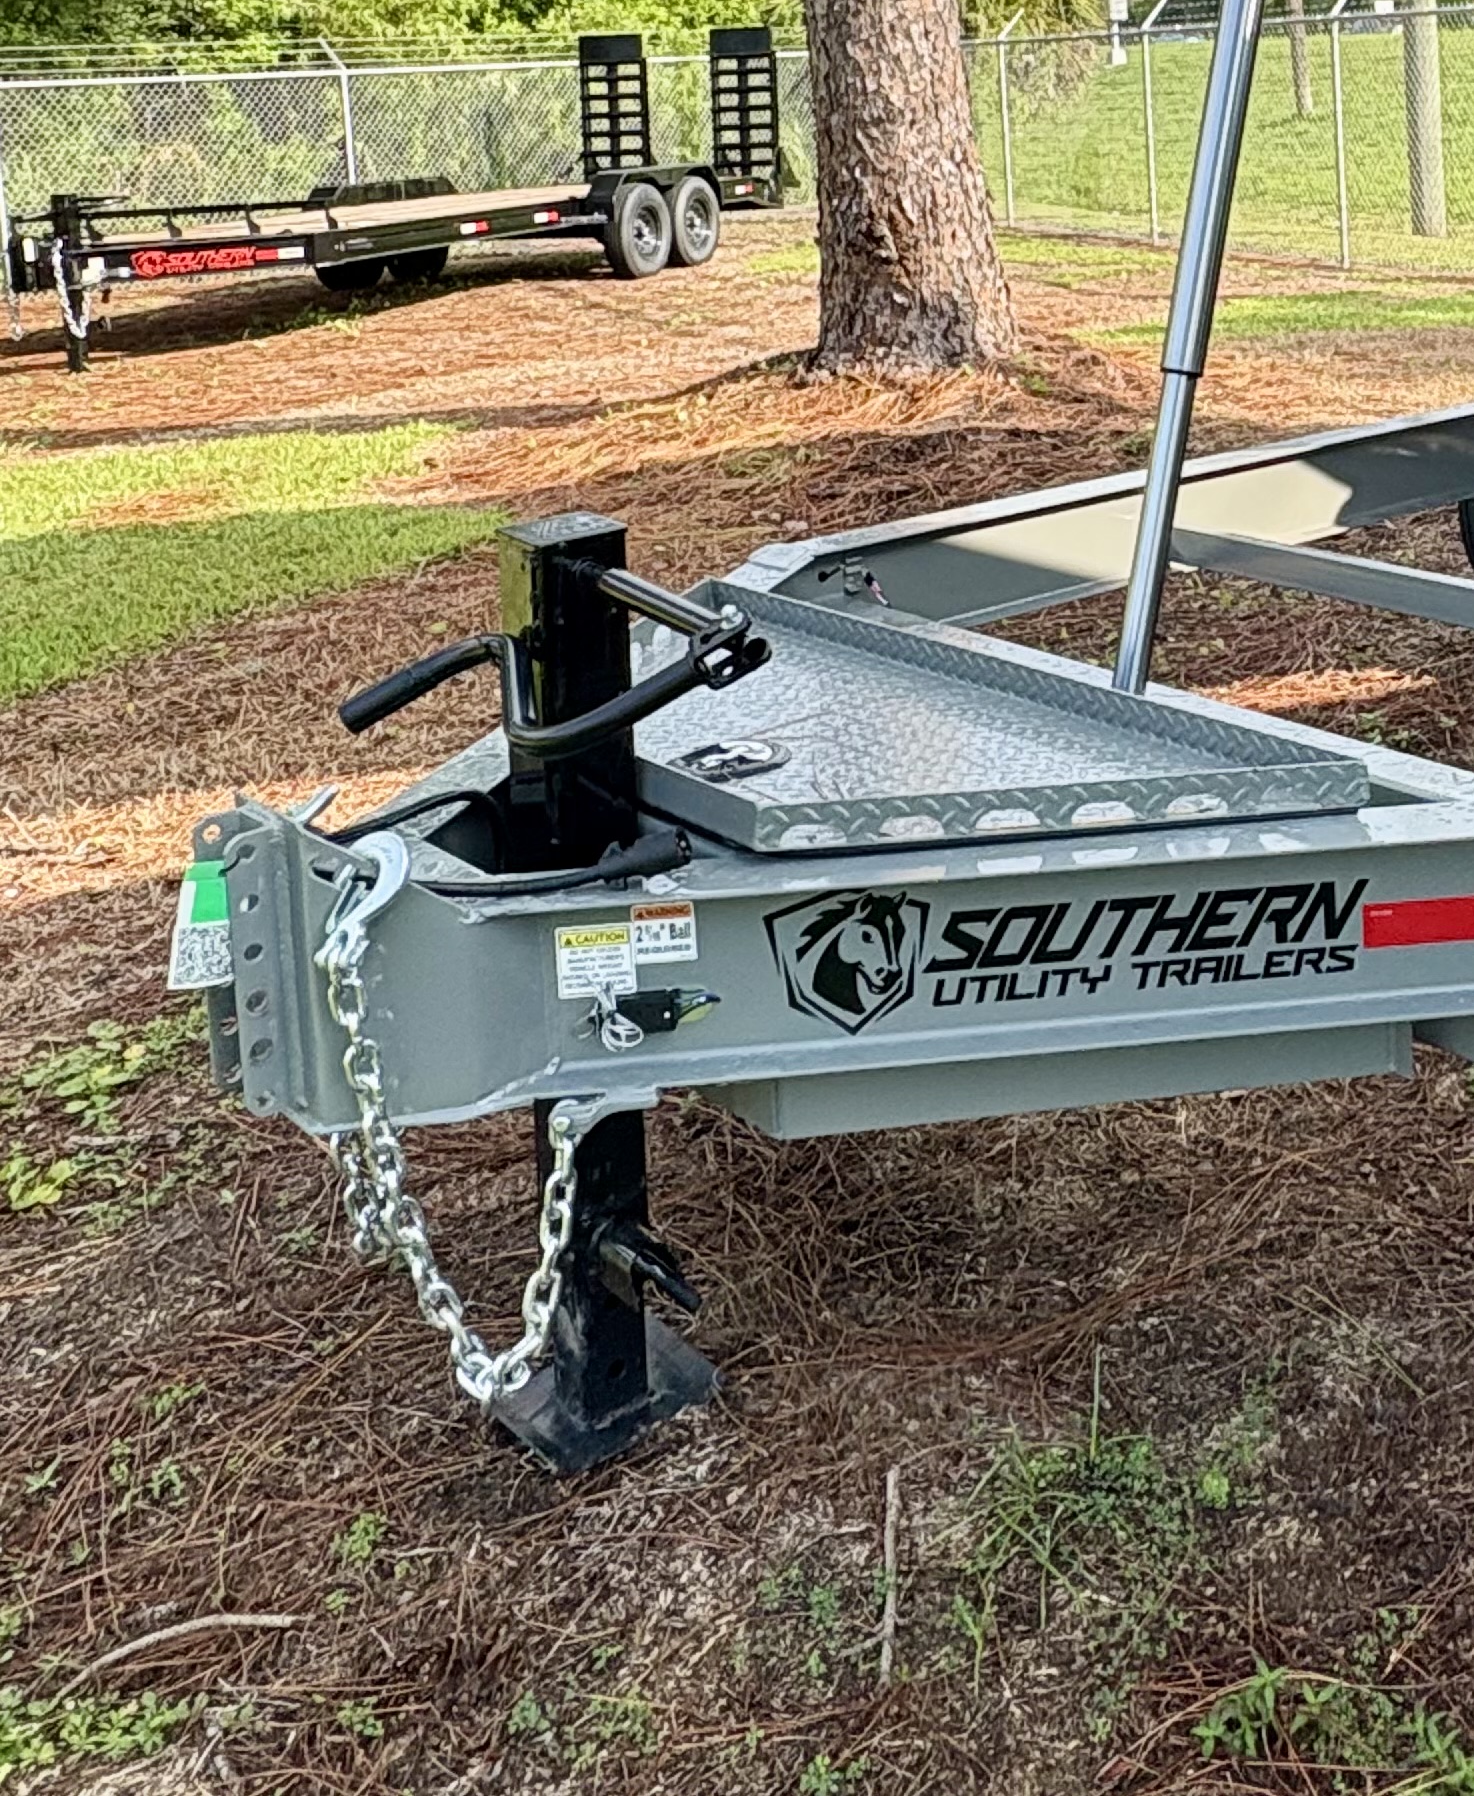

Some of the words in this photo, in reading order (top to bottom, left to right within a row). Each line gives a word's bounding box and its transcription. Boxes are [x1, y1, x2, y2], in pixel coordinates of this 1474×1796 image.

[575, 932, 625, 945] CAUTION
[669, 921, 691, 940] Ball
[923, 878, 1369, 973] SOUTHERN
[932, 965, 1112, 1007] UTILITY
[1131, 944, 1359, 990] TRAILERS
